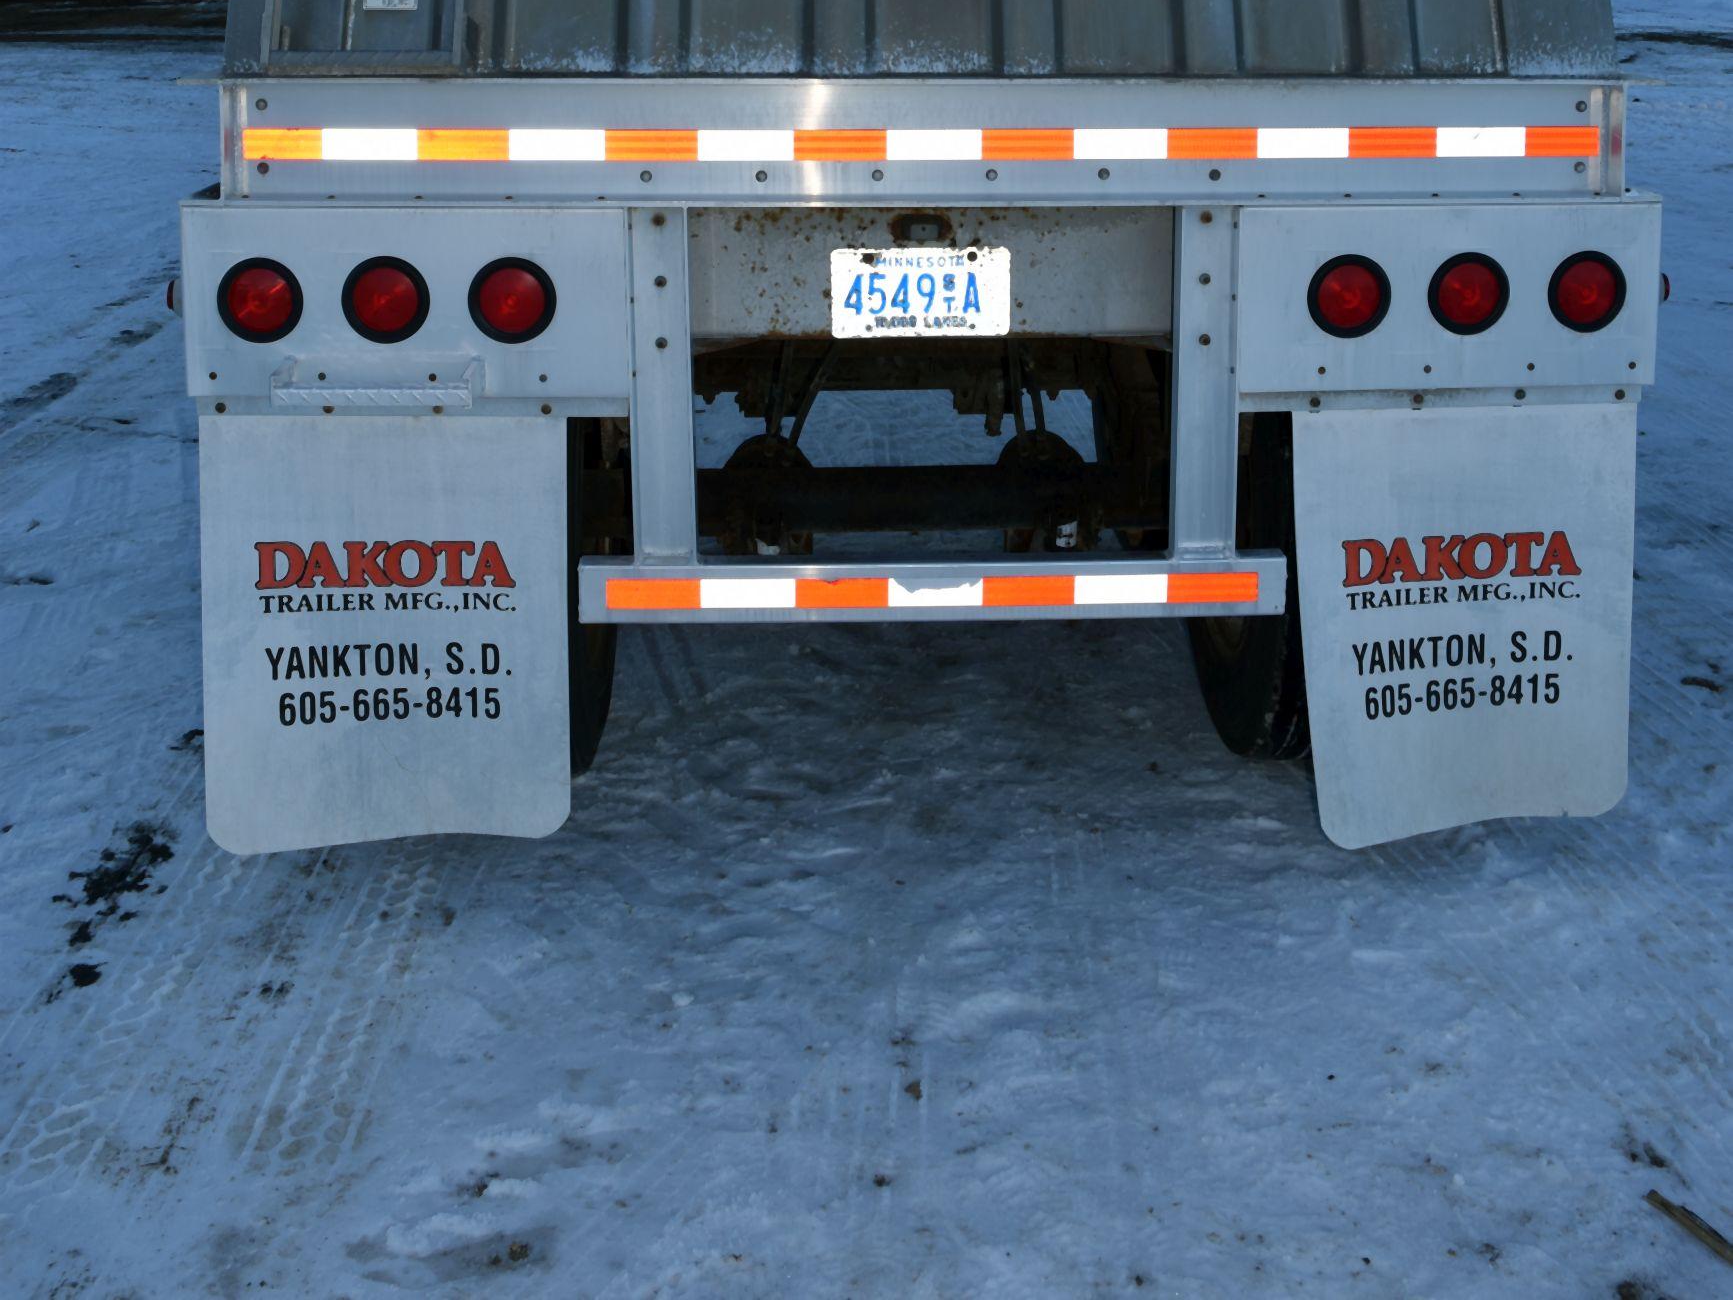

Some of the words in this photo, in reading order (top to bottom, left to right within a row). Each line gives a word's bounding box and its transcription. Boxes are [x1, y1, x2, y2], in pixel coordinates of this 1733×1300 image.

[875, 255, 965, 268] MINNESOTA
[254, 540, 516, 590] DAKOTA
[1342, 531, 1582, 588] DAKOTA
[259, 593, 375, 614] TRAILER
[1346, 586, 1448, 611] TRAILER
[265, 642, 431, 681] YANKTON,
[445, 641, 512, 676] S.D.
[1352, 633, 1496, 676] YANKTON,
[1510, 630, 1573, 663] S.D.
[279, 686, 501, 727] 605-665-8415
[1365, 672, 1560, 720] 605-665-8415
